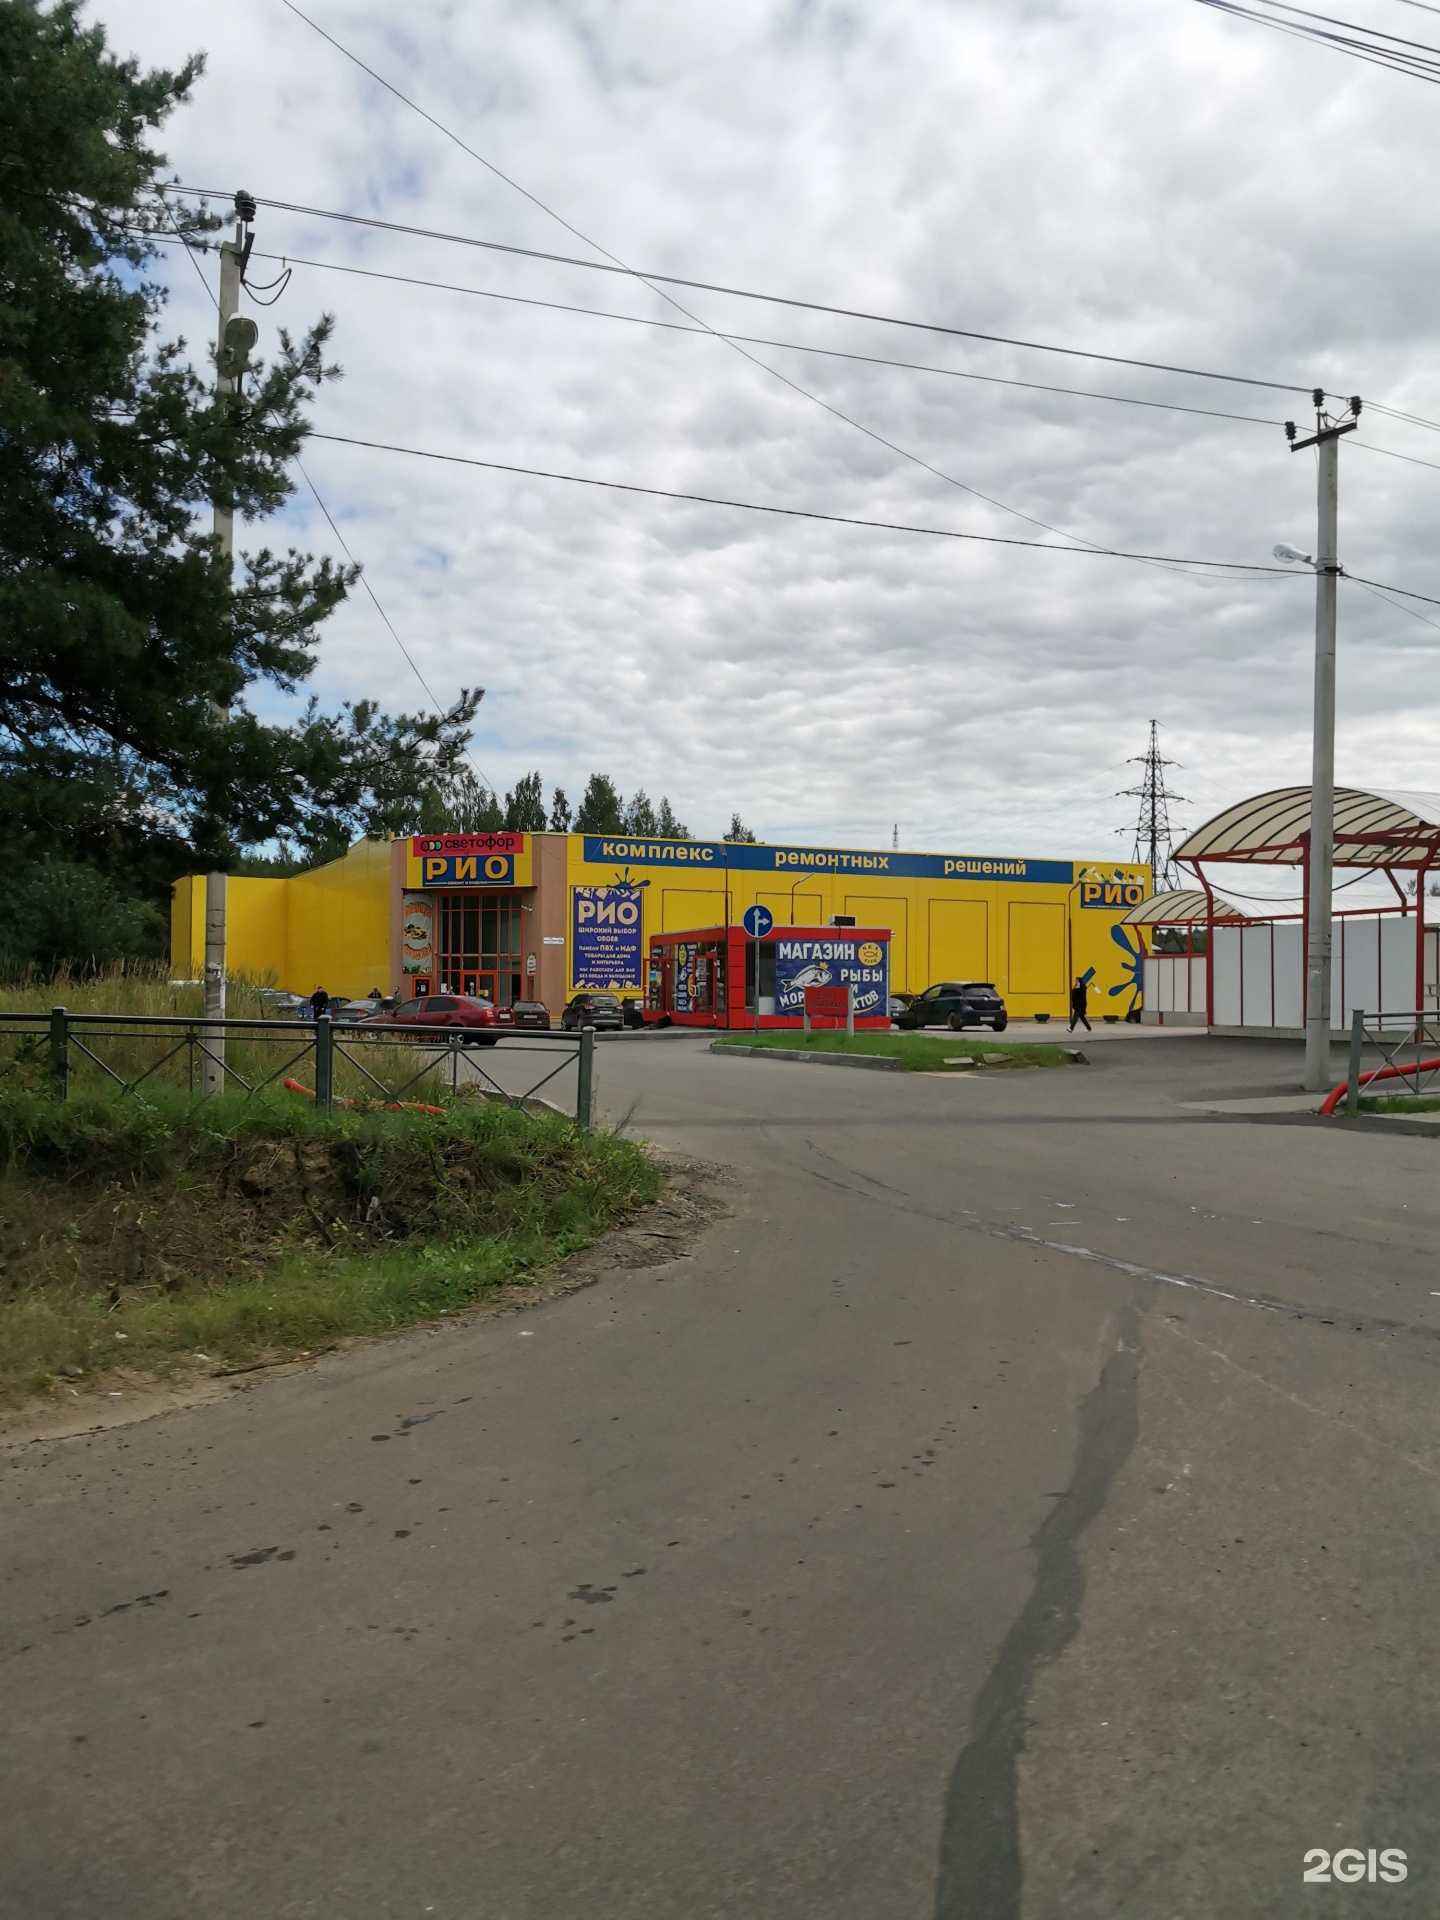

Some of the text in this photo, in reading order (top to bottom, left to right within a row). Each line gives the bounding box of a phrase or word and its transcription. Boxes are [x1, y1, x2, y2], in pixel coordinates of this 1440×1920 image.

[445, 835, 514, 850] светофор
[426, 855, 509, 880] РИО
[603, 842, 1027, 875] комплекс ремонтных решений
[1084, 884, 1143, 905] РИО
[578, 900, 638, 925] РИО
[779, 942, 855, 960] МАГАЗИН
[841, 968, 883, 982] РЫБЫ
